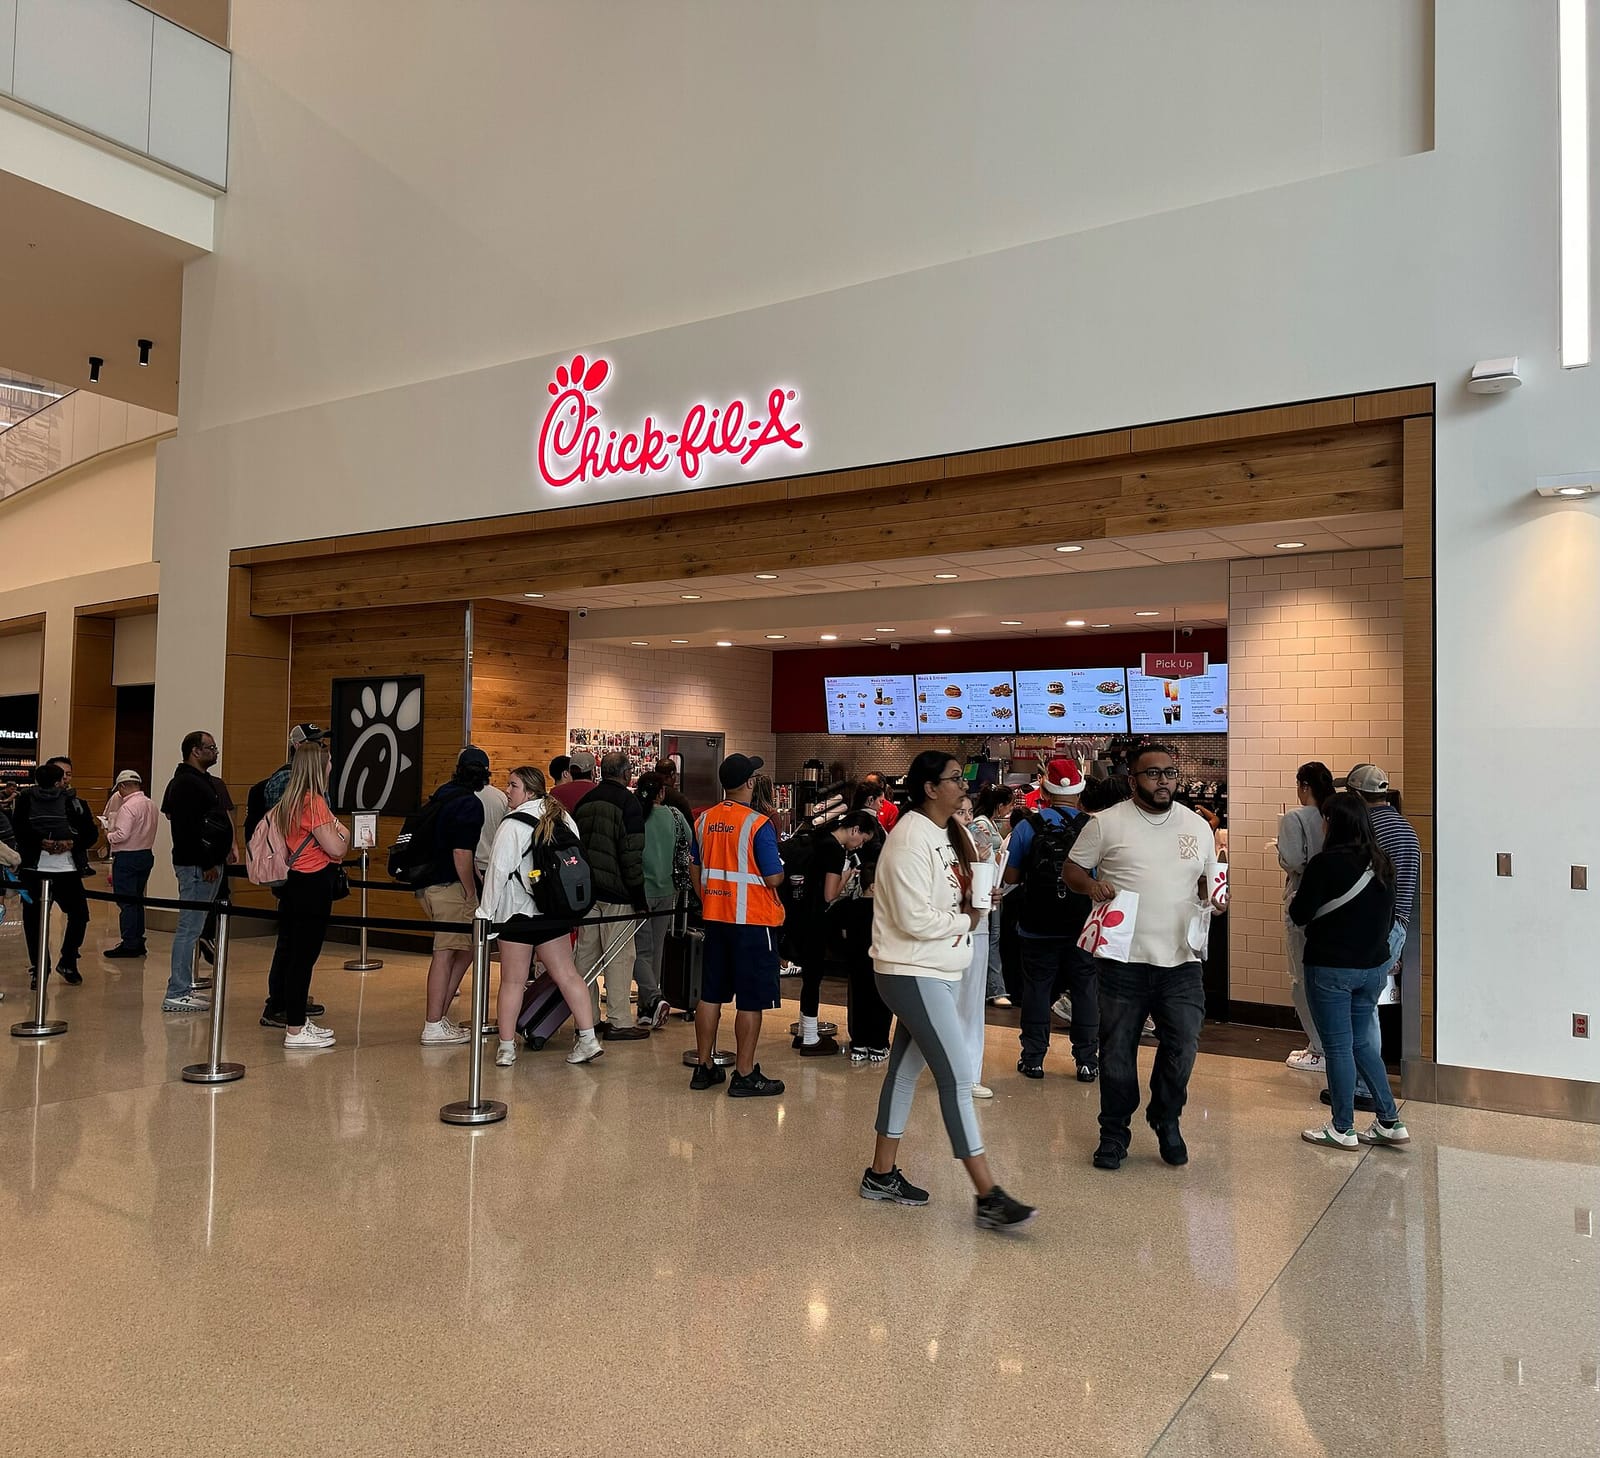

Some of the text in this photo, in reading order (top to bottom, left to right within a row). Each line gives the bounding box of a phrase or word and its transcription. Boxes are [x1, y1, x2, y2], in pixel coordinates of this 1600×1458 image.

[538, 388, 803, 487] Chick-fil-A
[1156, 659, 1193, 670] Pick Up
[0, 730, 34, 739] Natural
[707, 821, 735, 836] jetBlue
